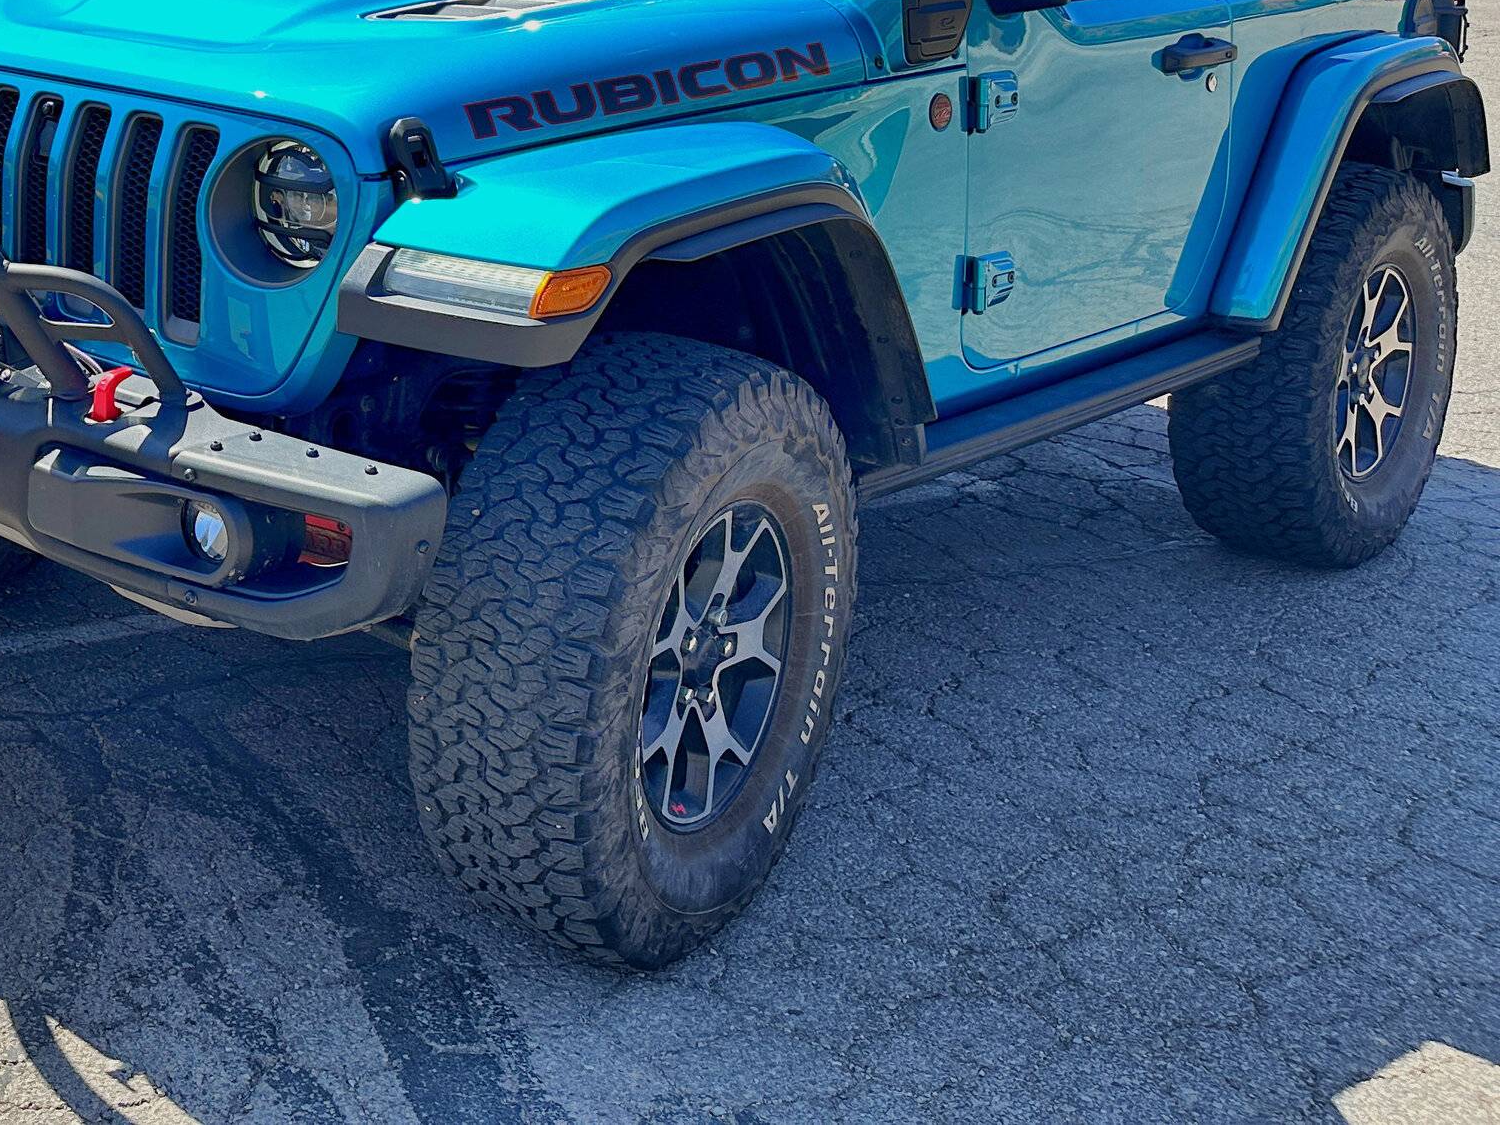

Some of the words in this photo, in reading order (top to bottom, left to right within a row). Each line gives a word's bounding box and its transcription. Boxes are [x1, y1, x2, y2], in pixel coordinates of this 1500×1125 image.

[462, 42, 831, 139] RUBICON
[1414, 237, 1446, 373] All-Terrain
[800, 503, 839, 745] All-Terrain
[762, 769, 799, 834] T/A
